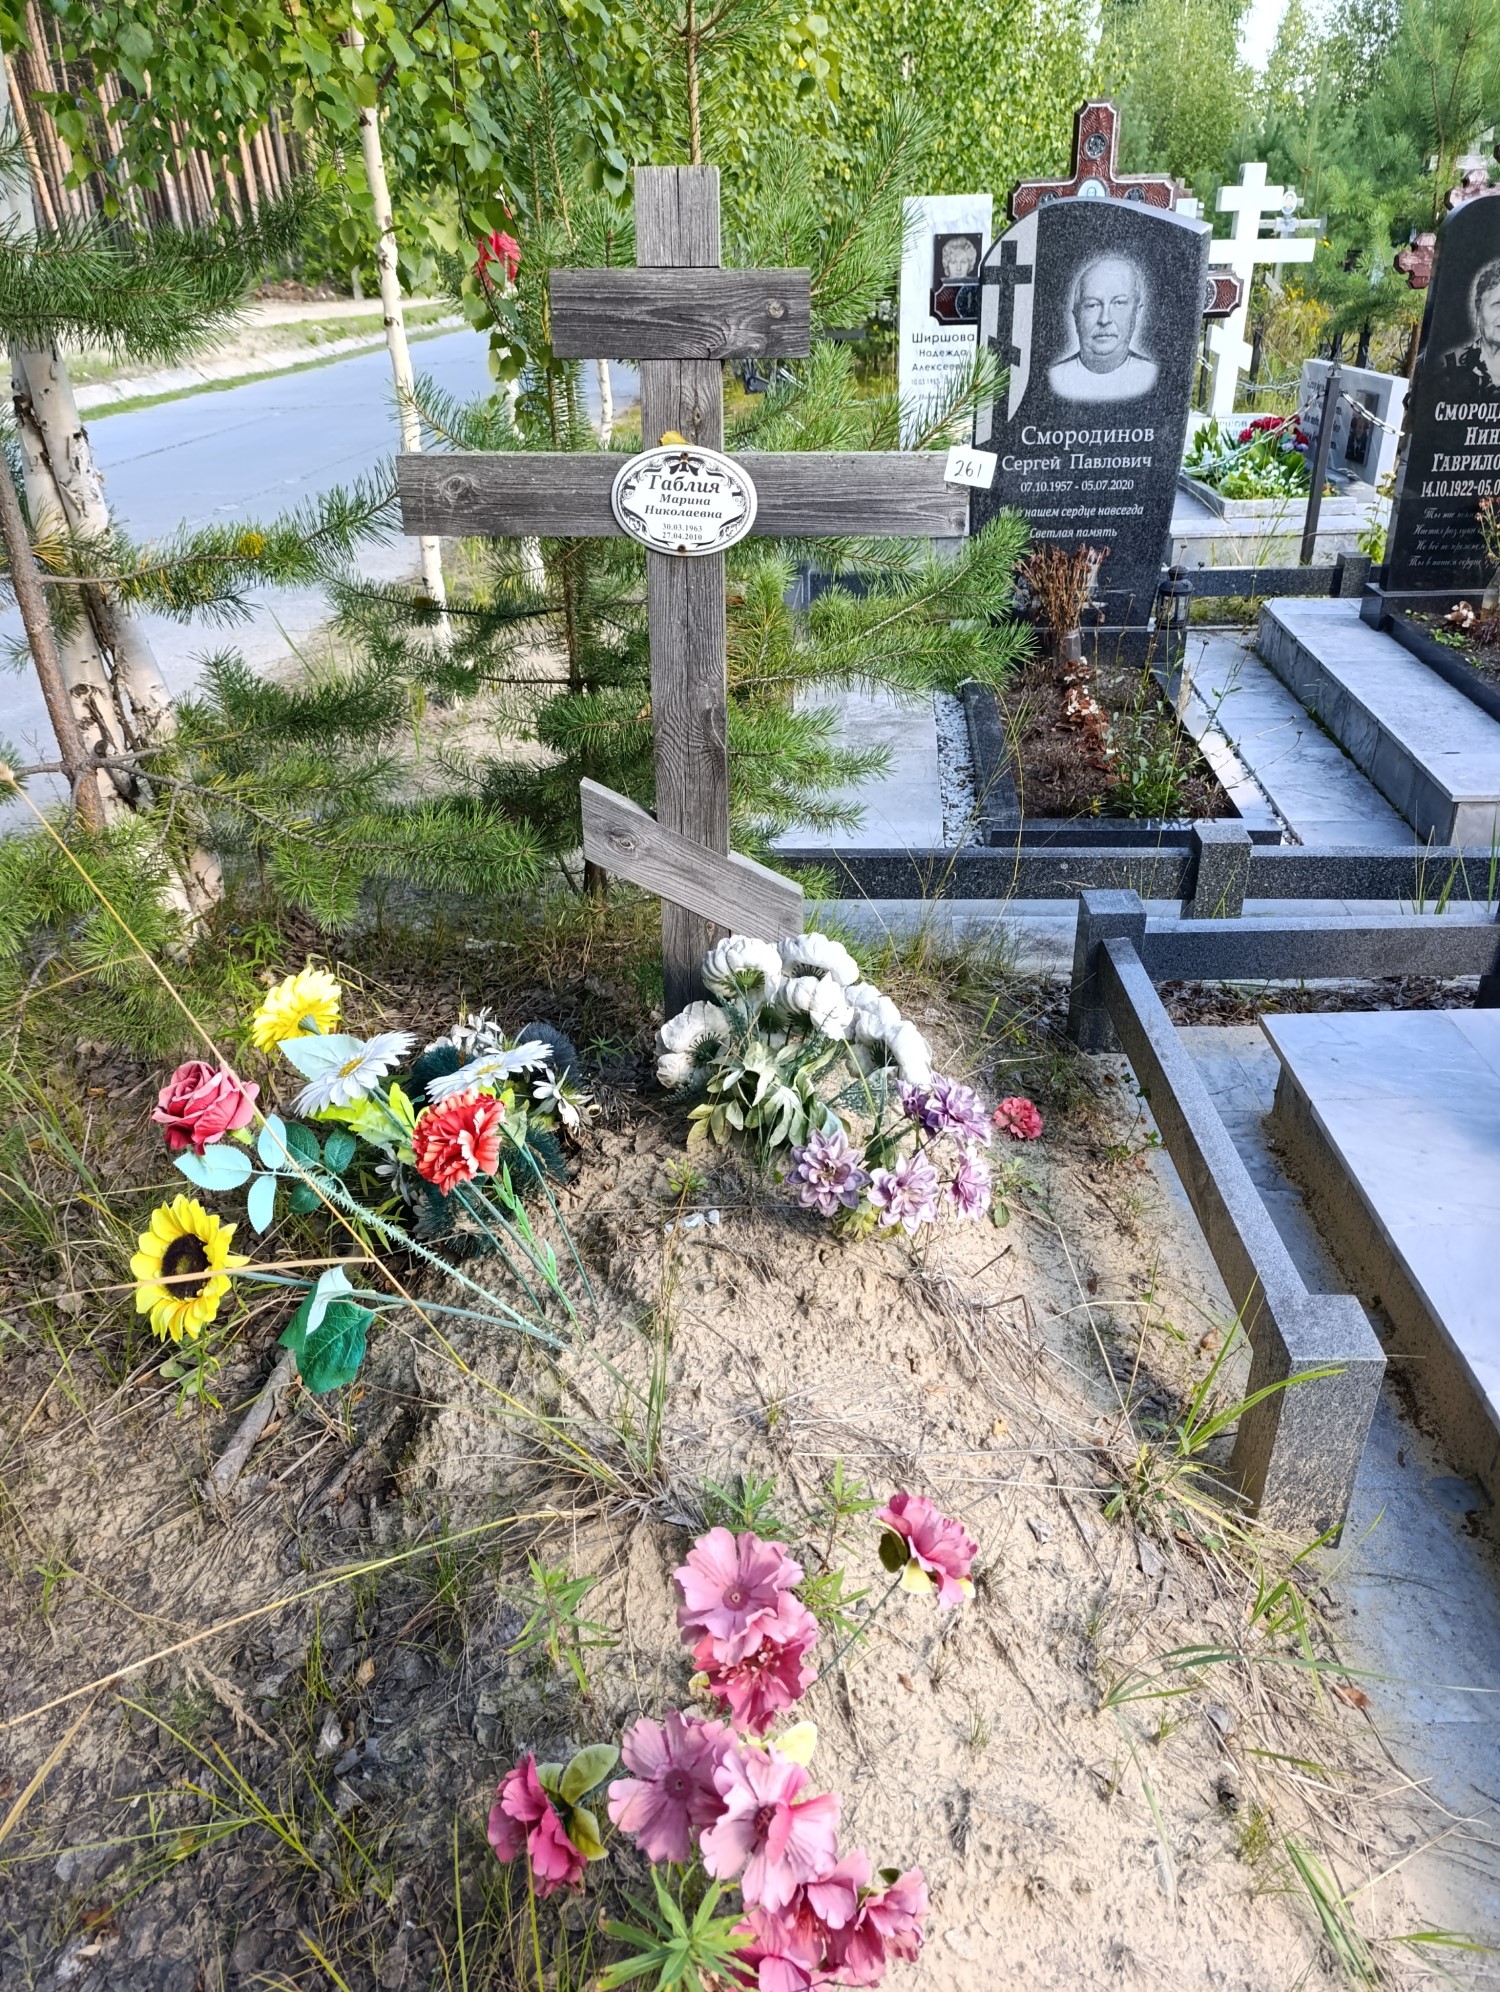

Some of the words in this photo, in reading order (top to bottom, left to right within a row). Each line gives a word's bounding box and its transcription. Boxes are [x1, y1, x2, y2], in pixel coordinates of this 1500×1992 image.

[912, 332, 975, 345] Ширшова
[919, 349, 967, 358] Надежда
[1434, 401, 1500, 423] СМОРОД
[1021, 426, 1154, 450] Смородинов
[1463, 426, 1500, 446] НИН
[954, 460, 982, 479] 261
[1001, 455, 1061, 475] Сергей
[1069, 453, 1152, 470] Павлович
[648, 474, 720, 494] Габлия
[1020, 481, 1073, 492] 07.10.1957
[1081, 480, 1134, 491] 05.07.2020
[659, 493, 711, 506] Марина
[644, 505, 722, 518] Николаевна
[1025, 507, 1059, 517] нашем
[1061, 505, 1096, 519] сердце
[1098, 504, 1144, 516] навсегда
[663, 522, 702, 532] 30.03.1963
[1030, 527, 1073, 538] Светлая
[1076, 528, 1118, 538] память
[663, 531, 702, 541] 27.04.2010
